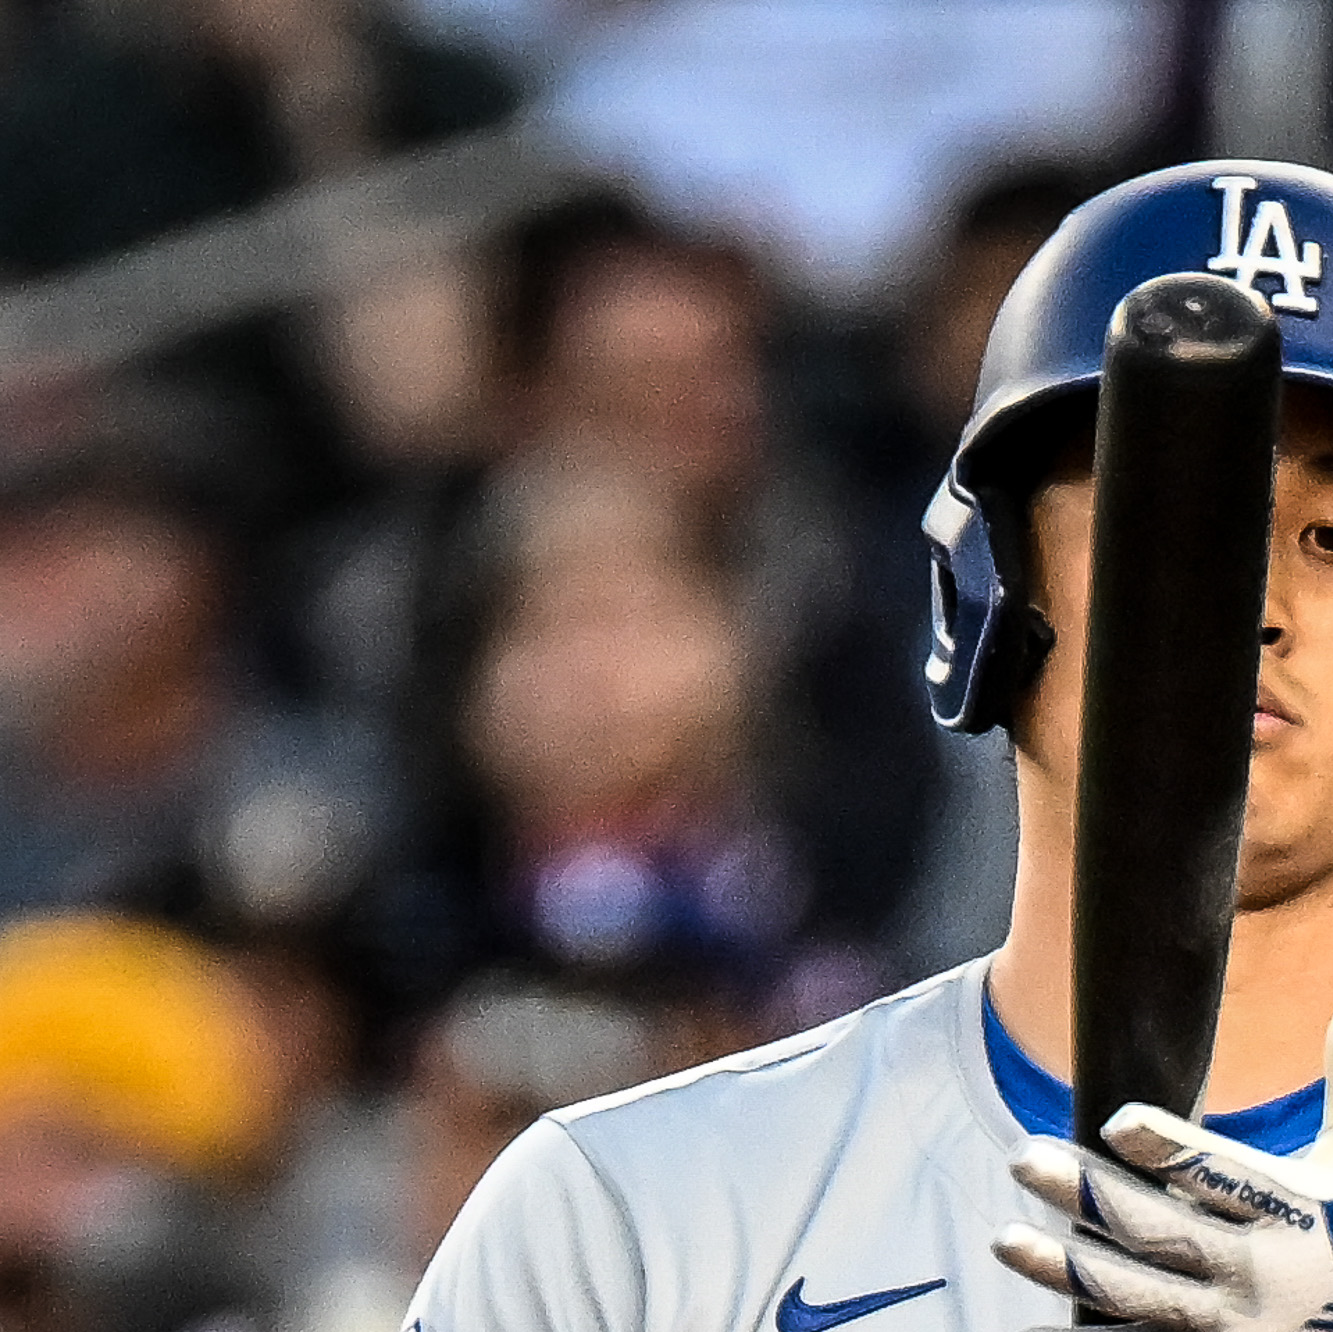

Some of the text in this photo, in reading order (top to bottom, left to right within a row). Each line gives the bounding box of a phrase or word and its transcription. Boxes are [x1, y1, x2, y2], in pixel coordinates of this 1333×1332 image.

[1207, 176, 1323, 314] LA
[1193, 1165, 1316, 1231] new balance
